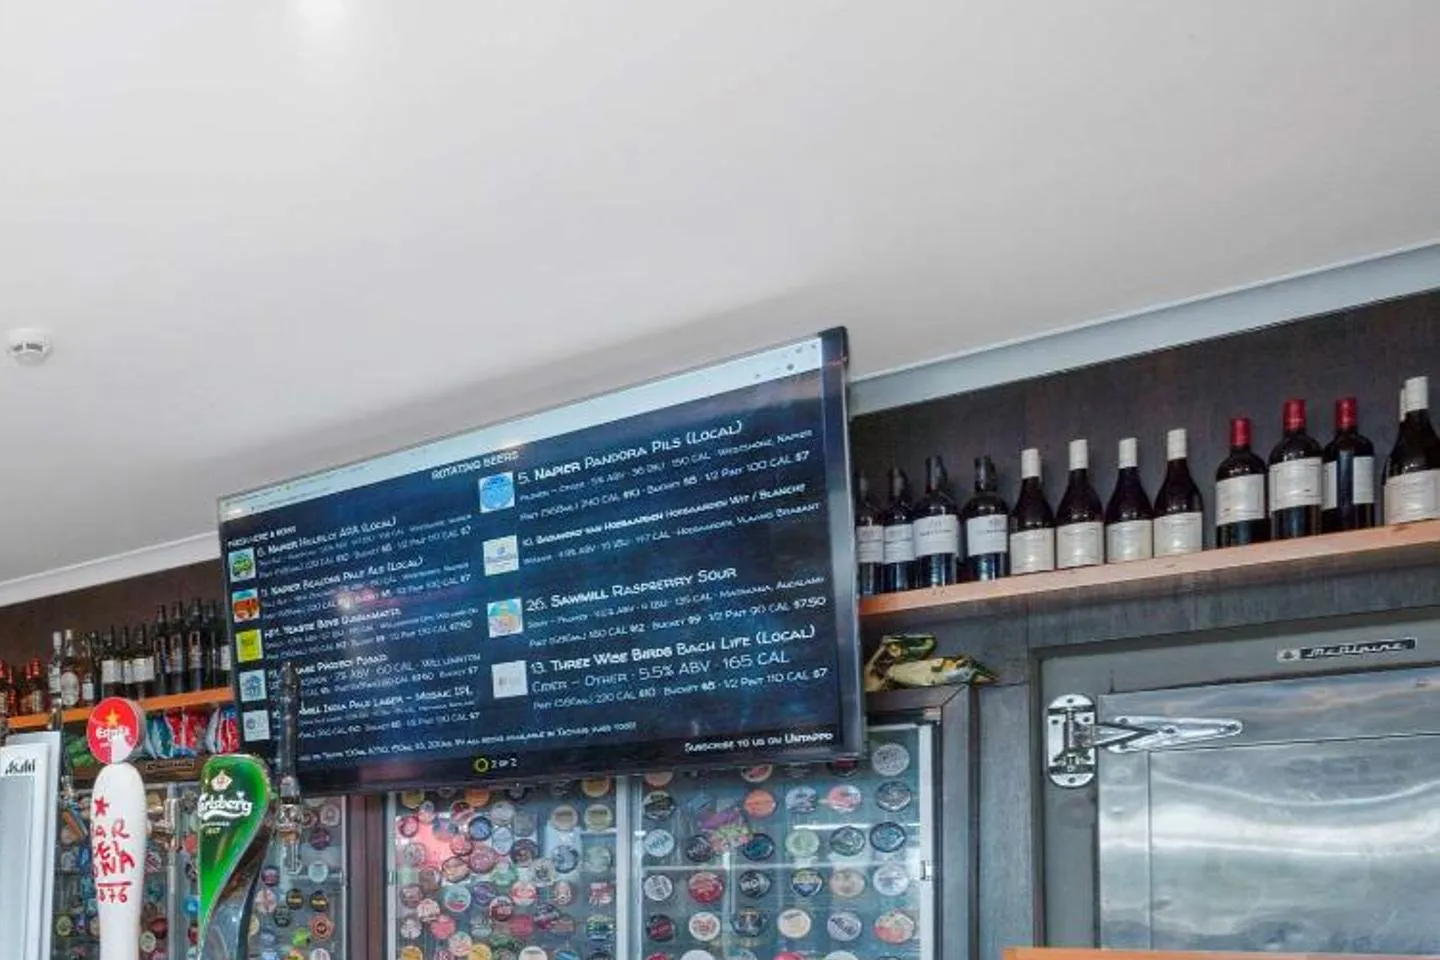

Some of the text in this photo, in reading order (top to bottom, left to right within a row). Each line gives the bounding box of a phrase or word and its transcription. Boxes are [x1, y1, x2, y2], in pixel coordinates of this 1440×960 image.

[533, 457, 581, 481] NAPIER
[584, 441, 647, 470] PANDORA
[651, 433, 681, 454] PILS
[686, 418, 743, 446] (LOCAL)
[769, 453, 793, 469] CAL
[550, 586, 609, 608] SAWMILL
[612, 572, 693, 598] RASPBERRY
[698, 564, 737, 584] SOUR
[549, 654, 591, 672] THREE
[592, 649, 627, 666] WISE
[631, 643, 673, 661] BIRDS
[676, 638, 715, 655] BACH
[720, 633, 751, 650] LIFE
[755, 624, 815, 645] (LOCAL)
[584, 669, 627, 686] OTHER
[678, 659, 711, 675] ABV
[722, 654, 753, 670] 165
[757, 649, 789, 666] CAL
[786, 670, 809, 682] CAL
[736, 737, 749, 748] TO
[751, 735, 765, 747] US
